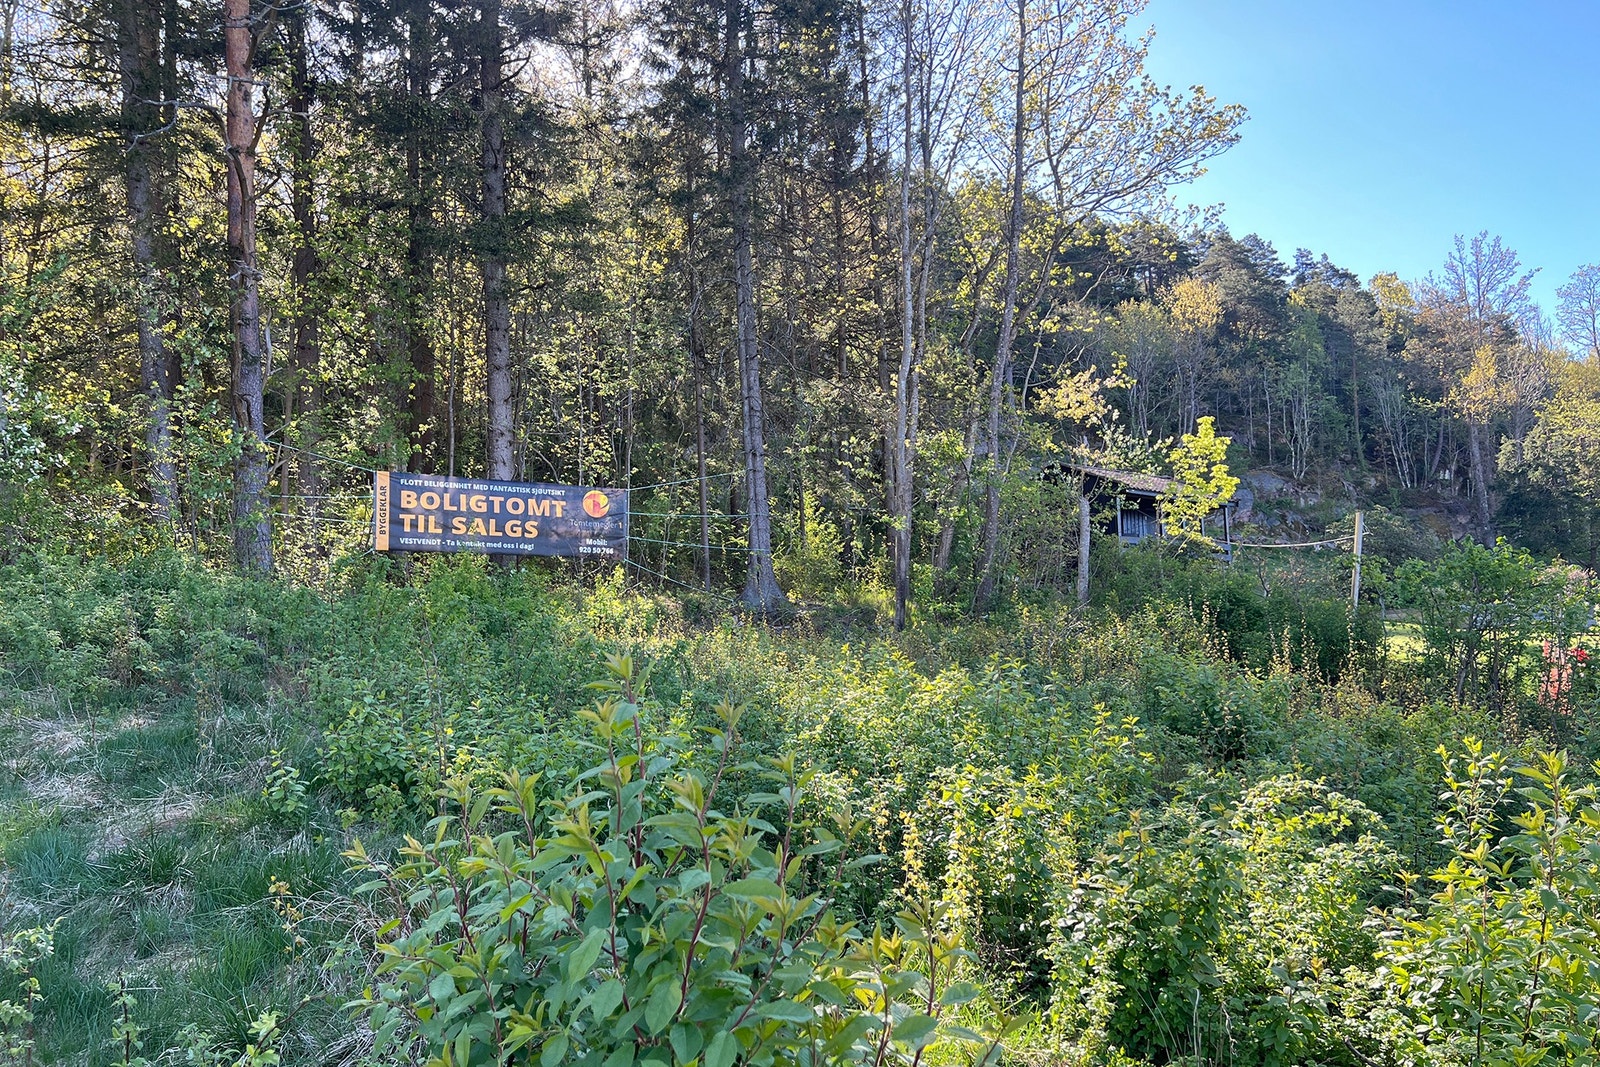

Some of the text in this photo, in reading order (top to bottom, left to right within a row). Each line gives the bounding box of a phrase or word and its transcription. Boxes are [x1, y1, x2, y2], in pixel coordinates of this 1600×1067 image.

[424, 480, 472, 490] BELIGGENHET
[490, 485, 531, 494] FANTASTISK
[532, 488, 566, 496] SJØUTSIKT
[380, 485, 388, 535] BYGGEKLAR
[400, 490, 567, 518] BOLIGTOMT
[399, 514, 539, 538] TIL SALGS
[400, 538, 441, 546] VESTVENDT
[520, 542, 534, 551] dag!
[586, 538, 608, 546] Mobil:
